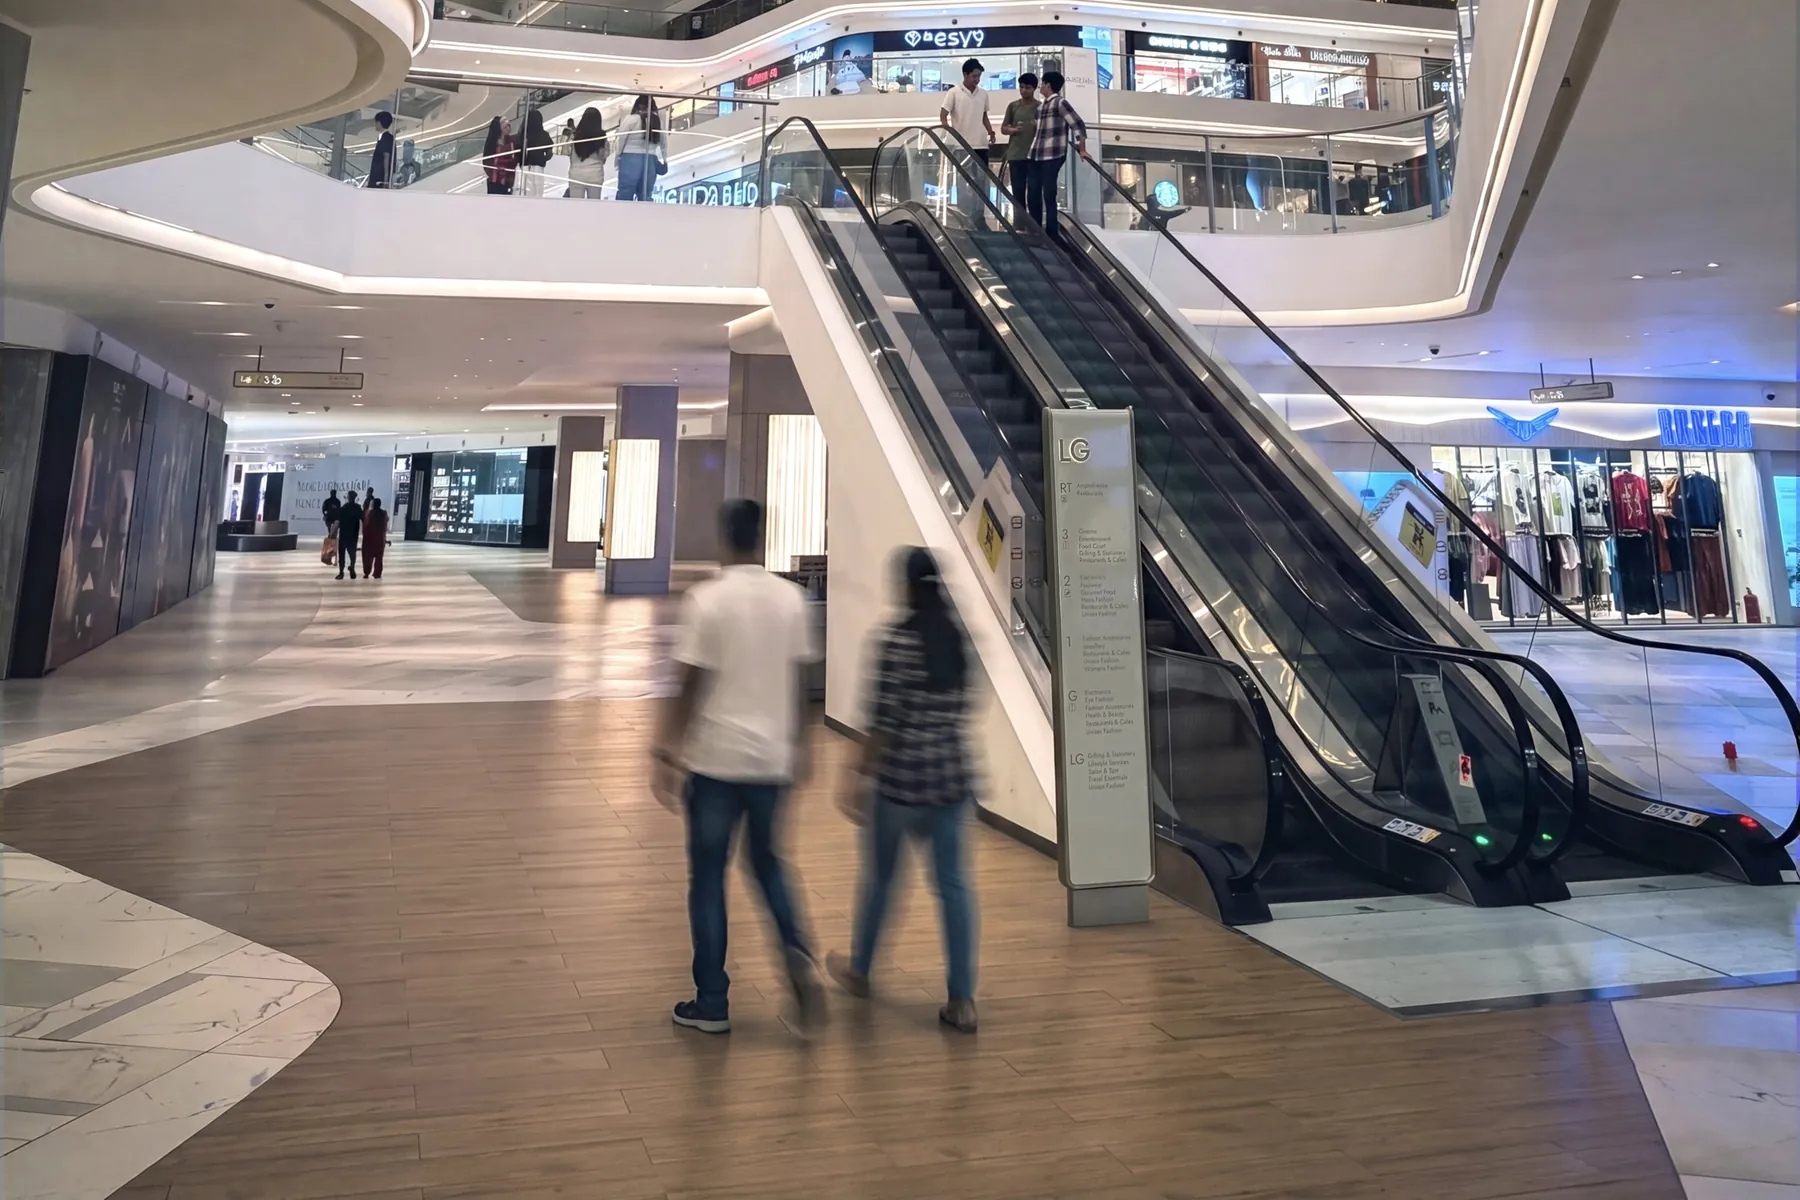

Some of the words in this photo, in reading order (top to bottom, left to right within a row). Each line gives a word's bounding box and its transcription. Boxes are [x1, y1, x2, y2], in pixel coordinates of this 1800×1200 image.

[1058, 437, 1092, 464] LG
[1060, 482, 1073, 494] RT
[1061, 528, 1069, 540] 3
[1063, 574, 1071, 587] 2
[1065, 635, 1071, 648] 1
[1068, 689, 1078, 702] G
[1070, 752, 1085, 766] LG
[1109, 767, 1119, 775] Spa
